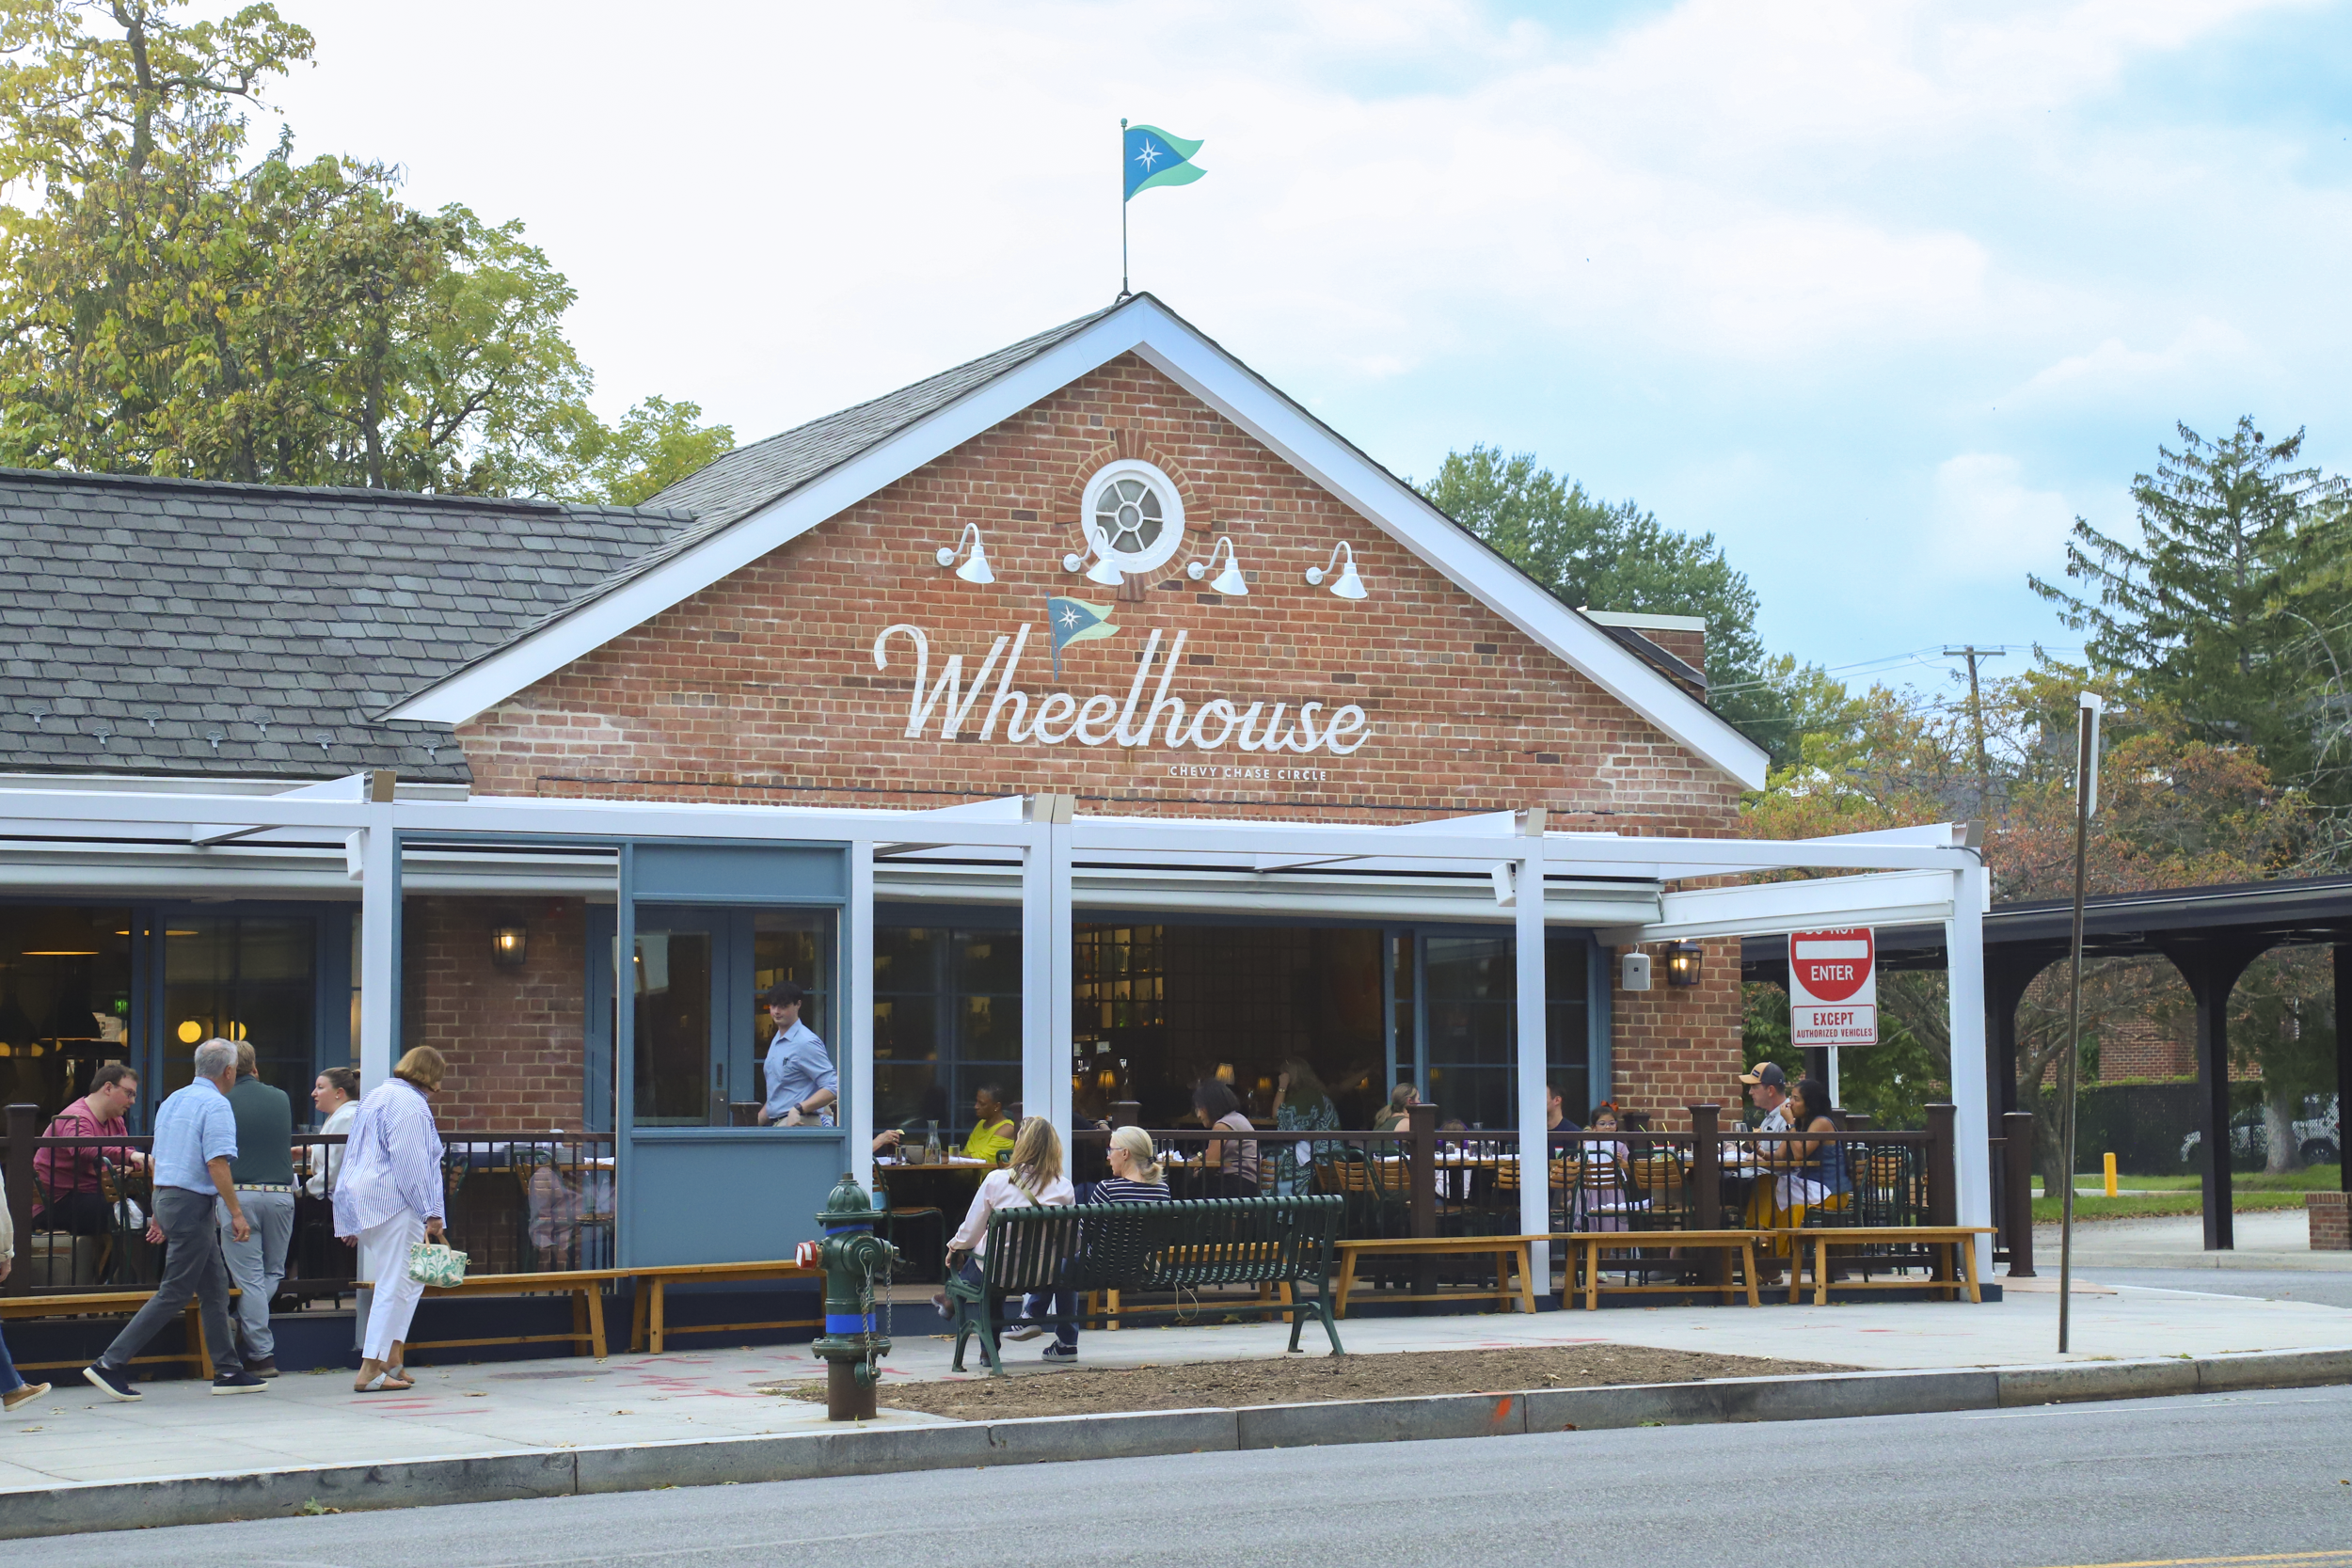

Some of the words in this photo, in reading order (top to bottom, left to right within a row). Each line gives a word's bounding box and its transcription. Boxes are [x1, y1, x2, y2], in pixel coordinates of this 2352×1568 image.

[874, 623, 1372, 755] Wheelhouse
[1169, 766, 1217, 777] CHEVY
[1224, 768, 1270, 779] CHASE
[1278, 769, 1327, 781] CIRCLE
[1810, 965, 1854, 981] ENTER
[1813, 1012, 1854, 1026] EXCEPT
[1796, 1028, 1838, 1038] AUTHORIZED
[1840, 1027, 1873, 1037] VEHICLES
